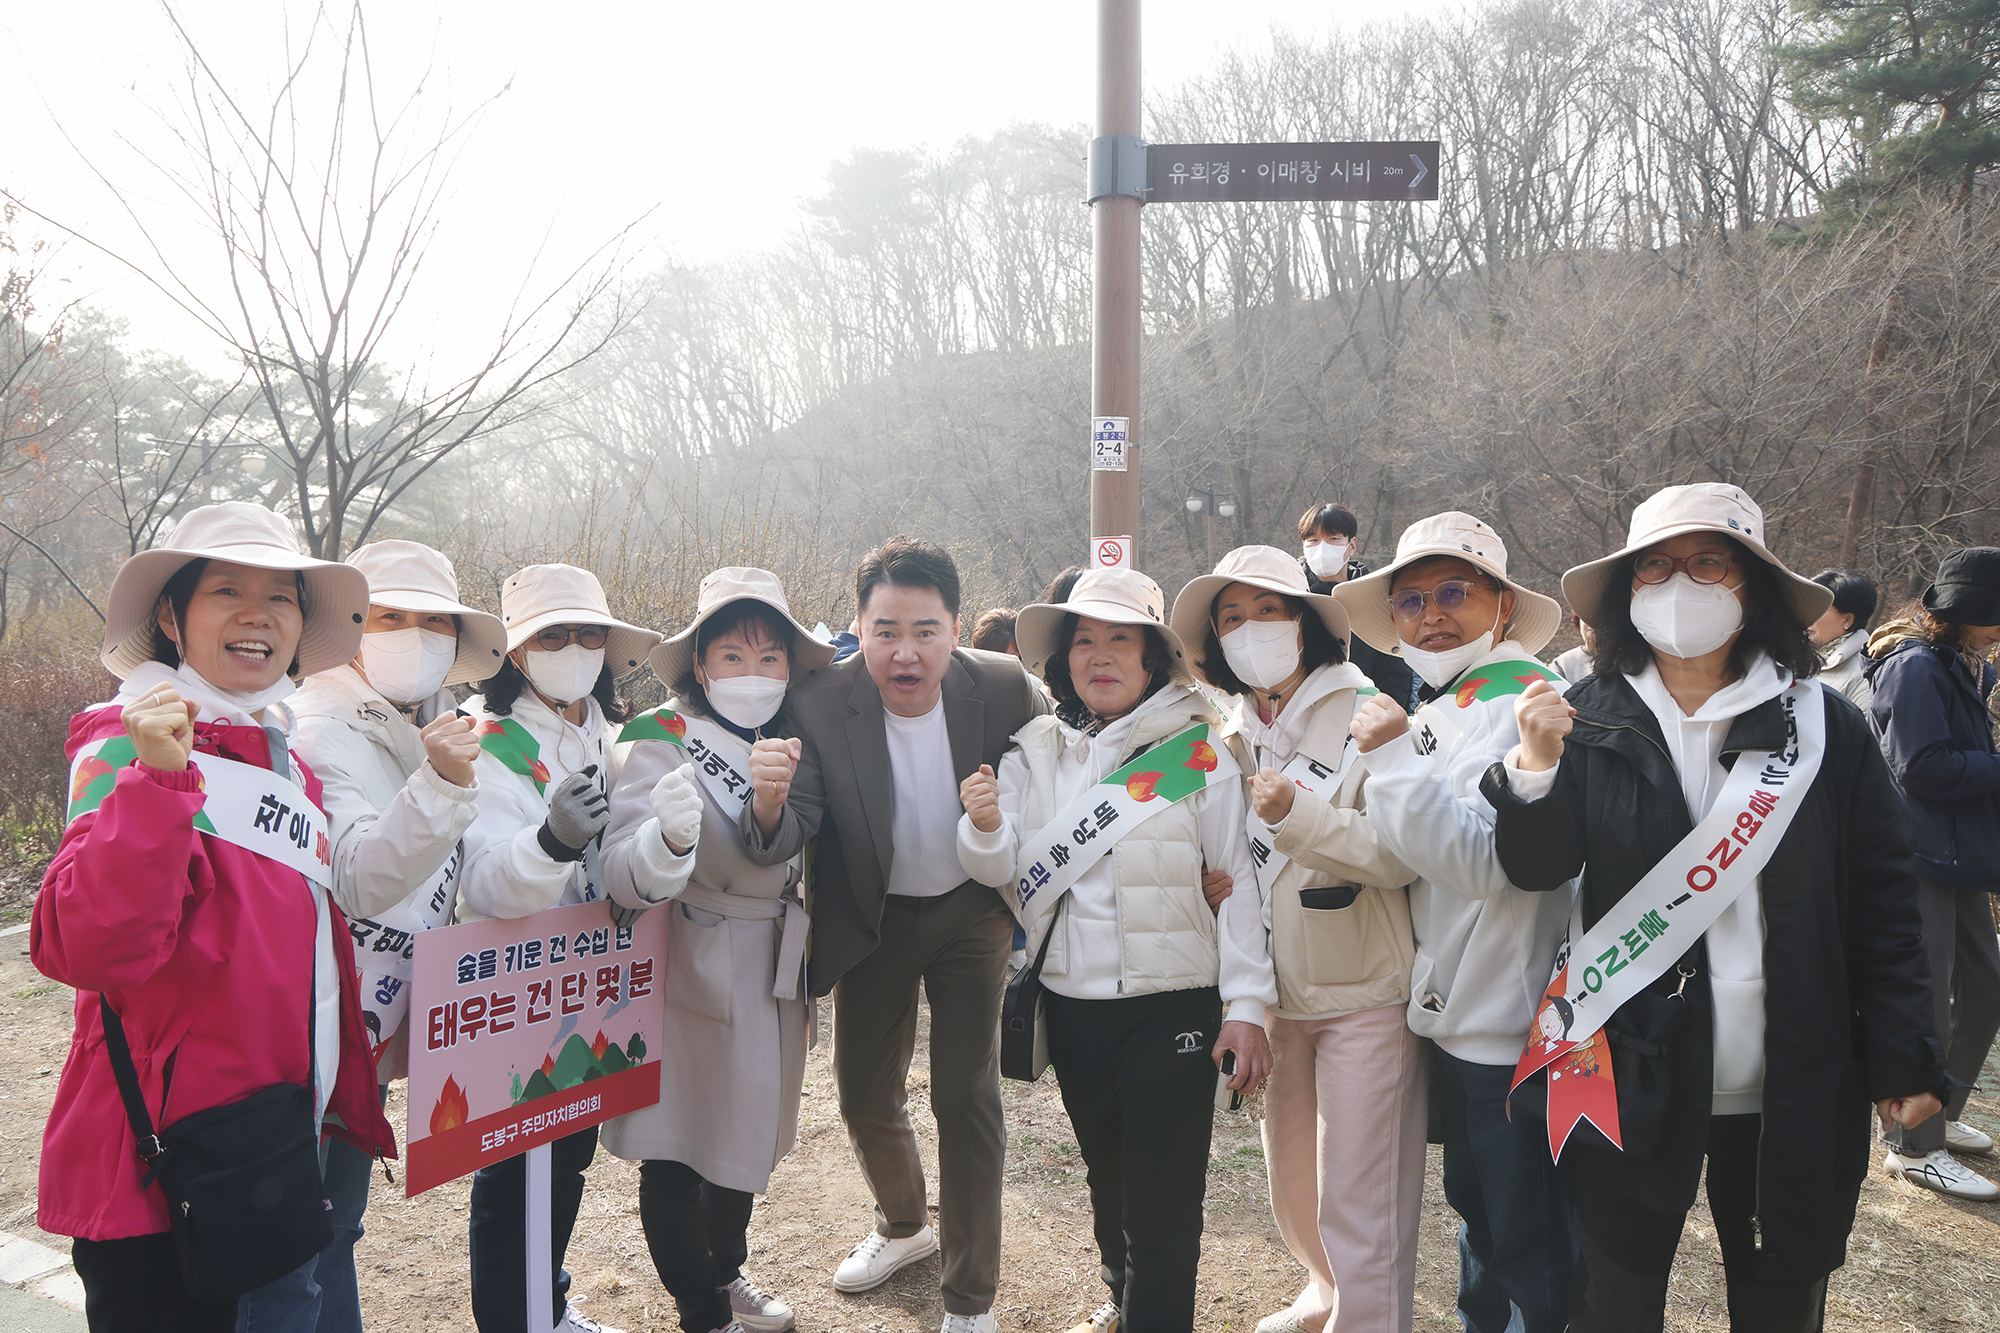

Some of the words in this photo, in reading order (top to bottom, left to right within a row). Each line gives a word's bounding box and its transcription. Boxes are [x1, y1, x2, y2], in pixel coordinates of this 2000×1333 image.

[1168, 161, 1231, 186] 유희경
[1257, 159, 1322, 185] 이매창
[1330, 159, 1372, 184] 시비
[1383, 165, 1404, 177] 20m
[1096, 442, 1122, 456] 2-4
[253, 793, 311, 850] 작은
[1072, 799, 1120, 846] 배낭
[1048, 842, 1071, 869] 속
[457, 948, 498, 985] 숲을
[504, 939, 543, 974] 키운
[549, 935, 567, 964] 건
[573, 927, 609, 958] 수십
[615, 925, 633, 951] 년
[426, 991, 517, 1052] 태우는
[526, 979, 552, 1025] 건
[561, 971, 588, 1016] 단
[595, 964, 620, 1007] 몇
[628, 957, 653, 999] 분
[480, 1122, 519, 1153] 도봉구
[521, 1093, 602, 1137] 주민자치협의회
